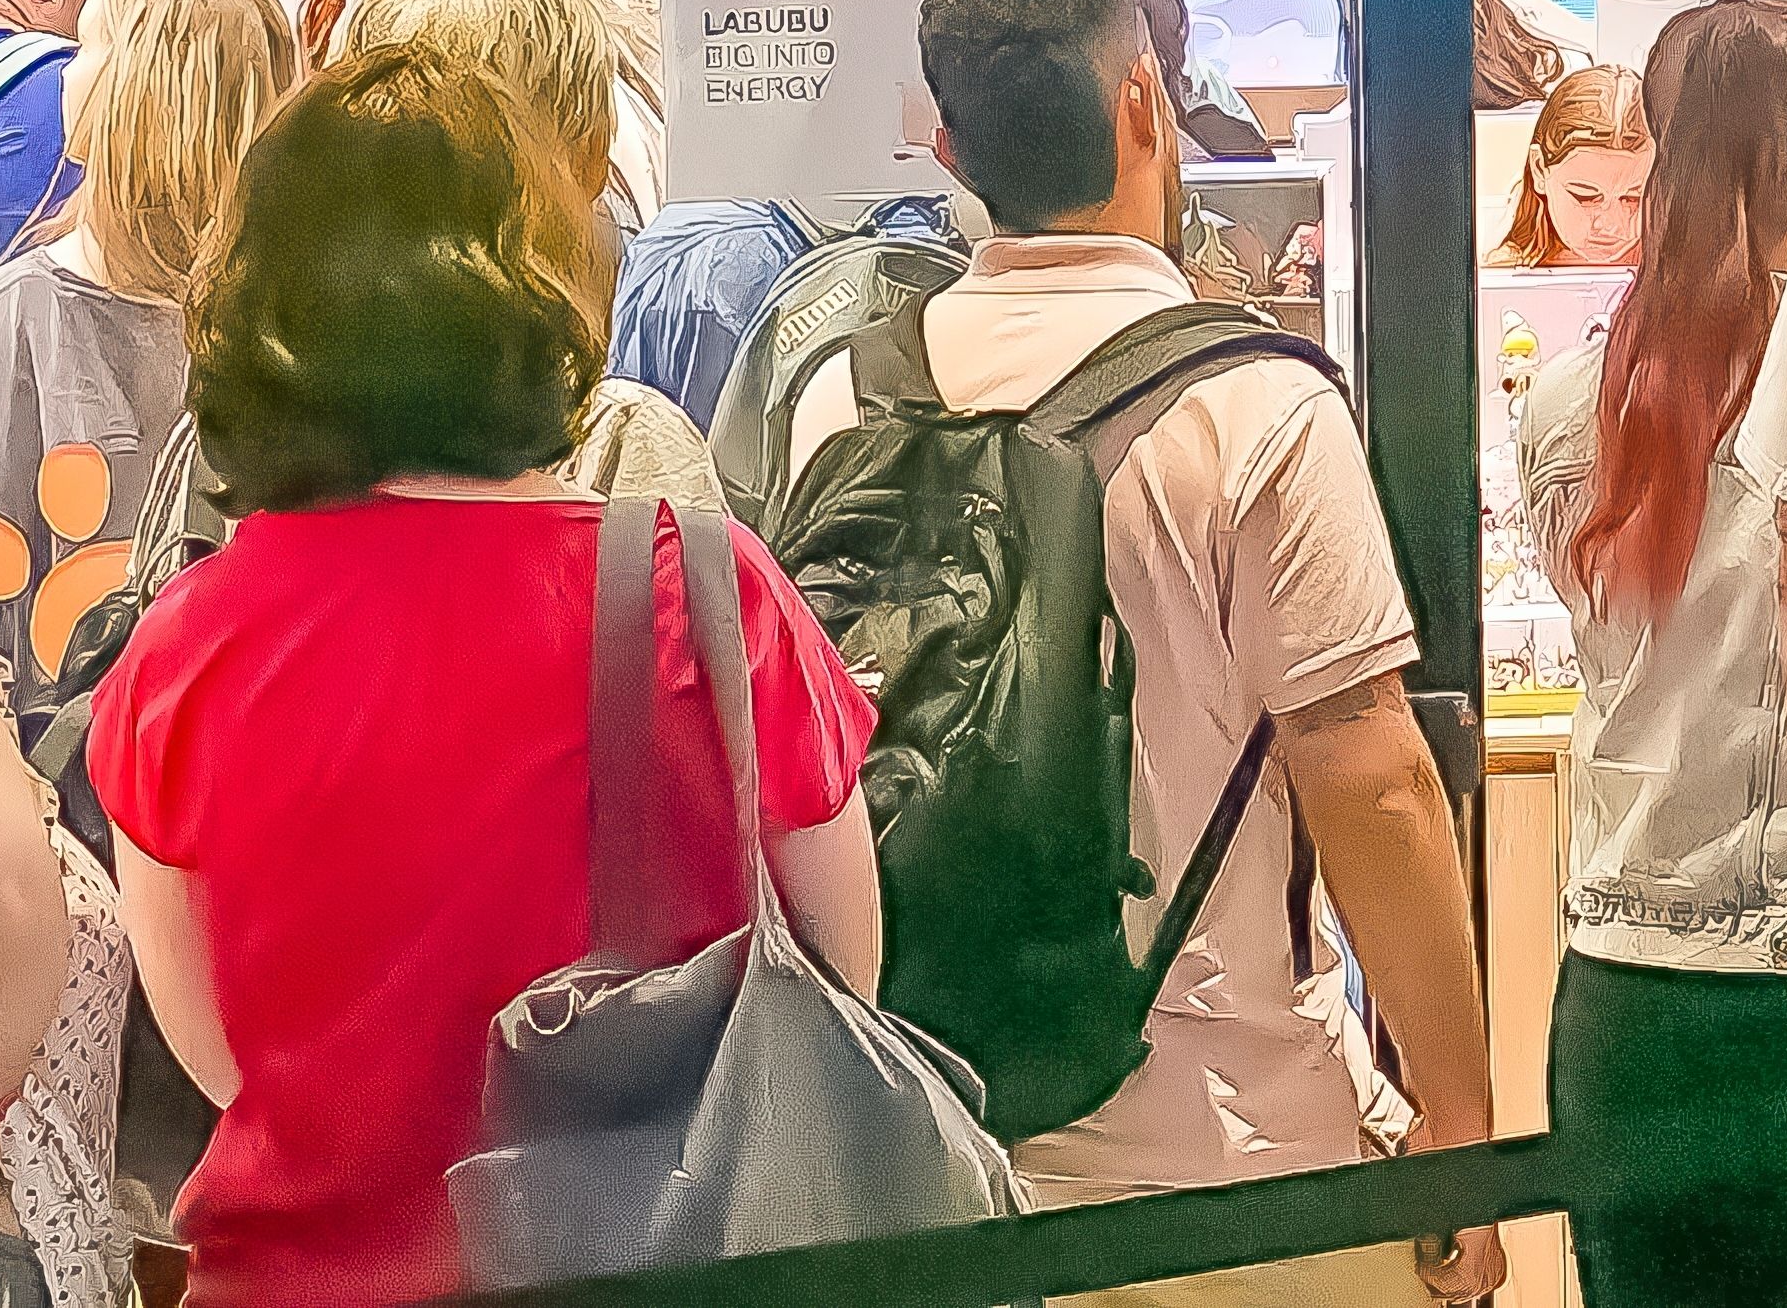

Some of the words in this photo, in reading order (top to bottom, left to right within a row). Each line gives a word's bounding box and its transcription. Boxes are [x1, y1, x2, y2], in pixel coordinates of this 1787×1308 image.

[704, 7, 829, 37] LABUBU
[767, 40, 835, 68] INTO
[705, 72, 832, 103] ENERGY
